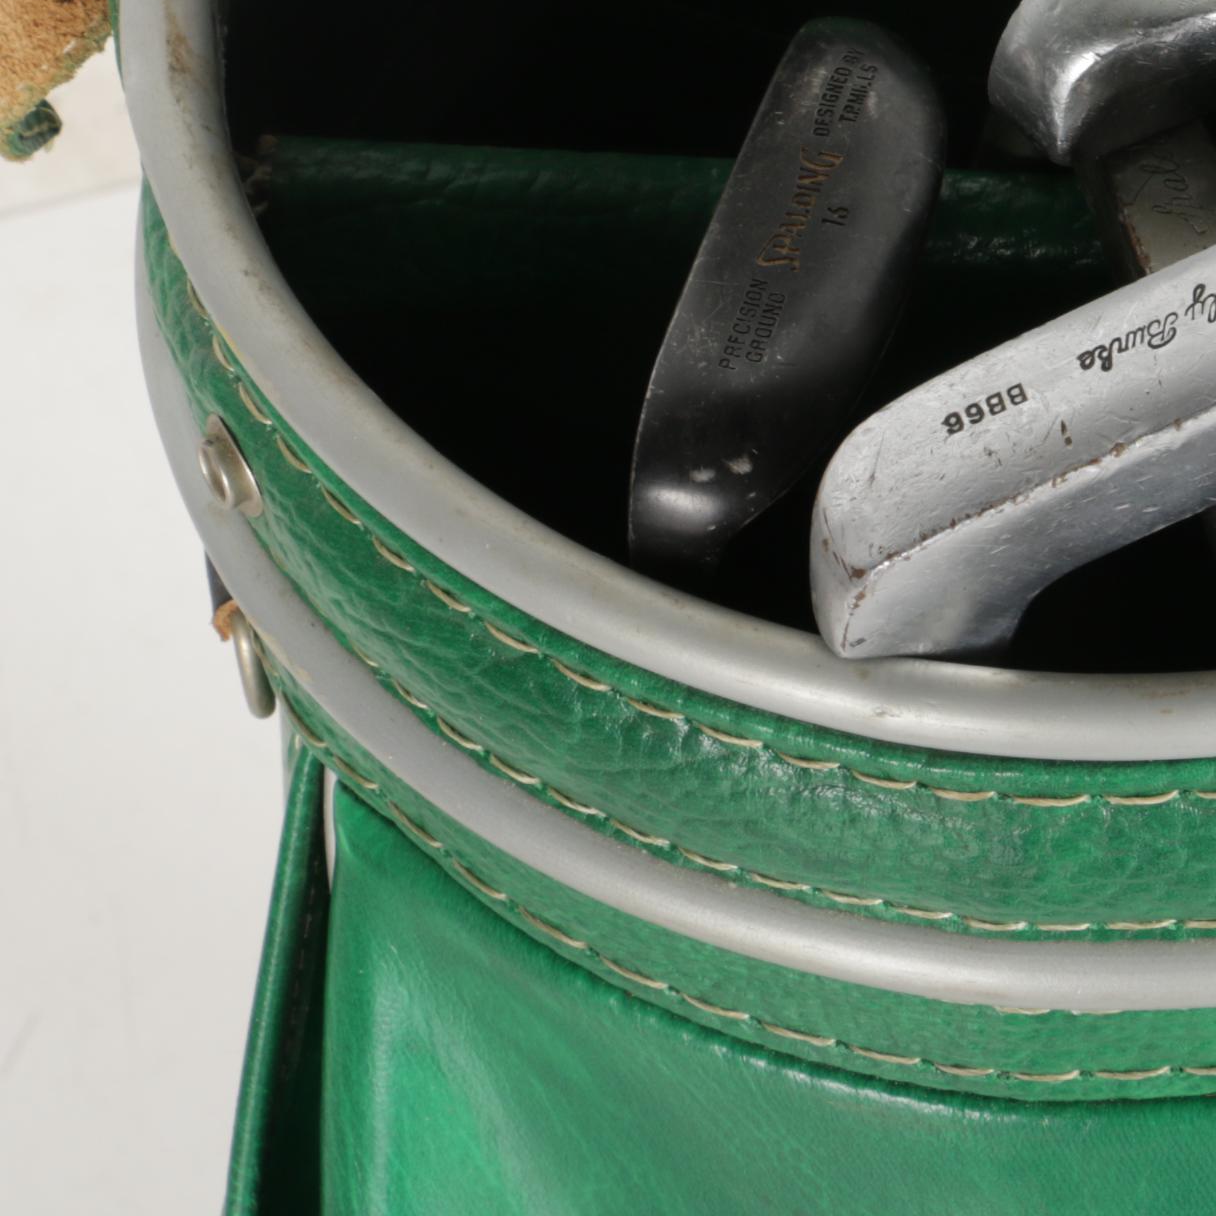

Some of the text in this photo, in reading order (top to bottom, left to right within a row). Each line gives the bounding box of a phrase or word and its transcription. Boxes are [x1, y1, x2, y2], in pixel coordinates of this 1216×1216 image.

[813, 67, 853, 137] DESIGNED
[756, 147, 845, 273] SPALDING
[719, 278, 769, 371] PRECISION
[745, 292, 787, 364] GROUND
[1076, 311, 1178, 372] Burke
[941, 383, 1029, 435] BB66
